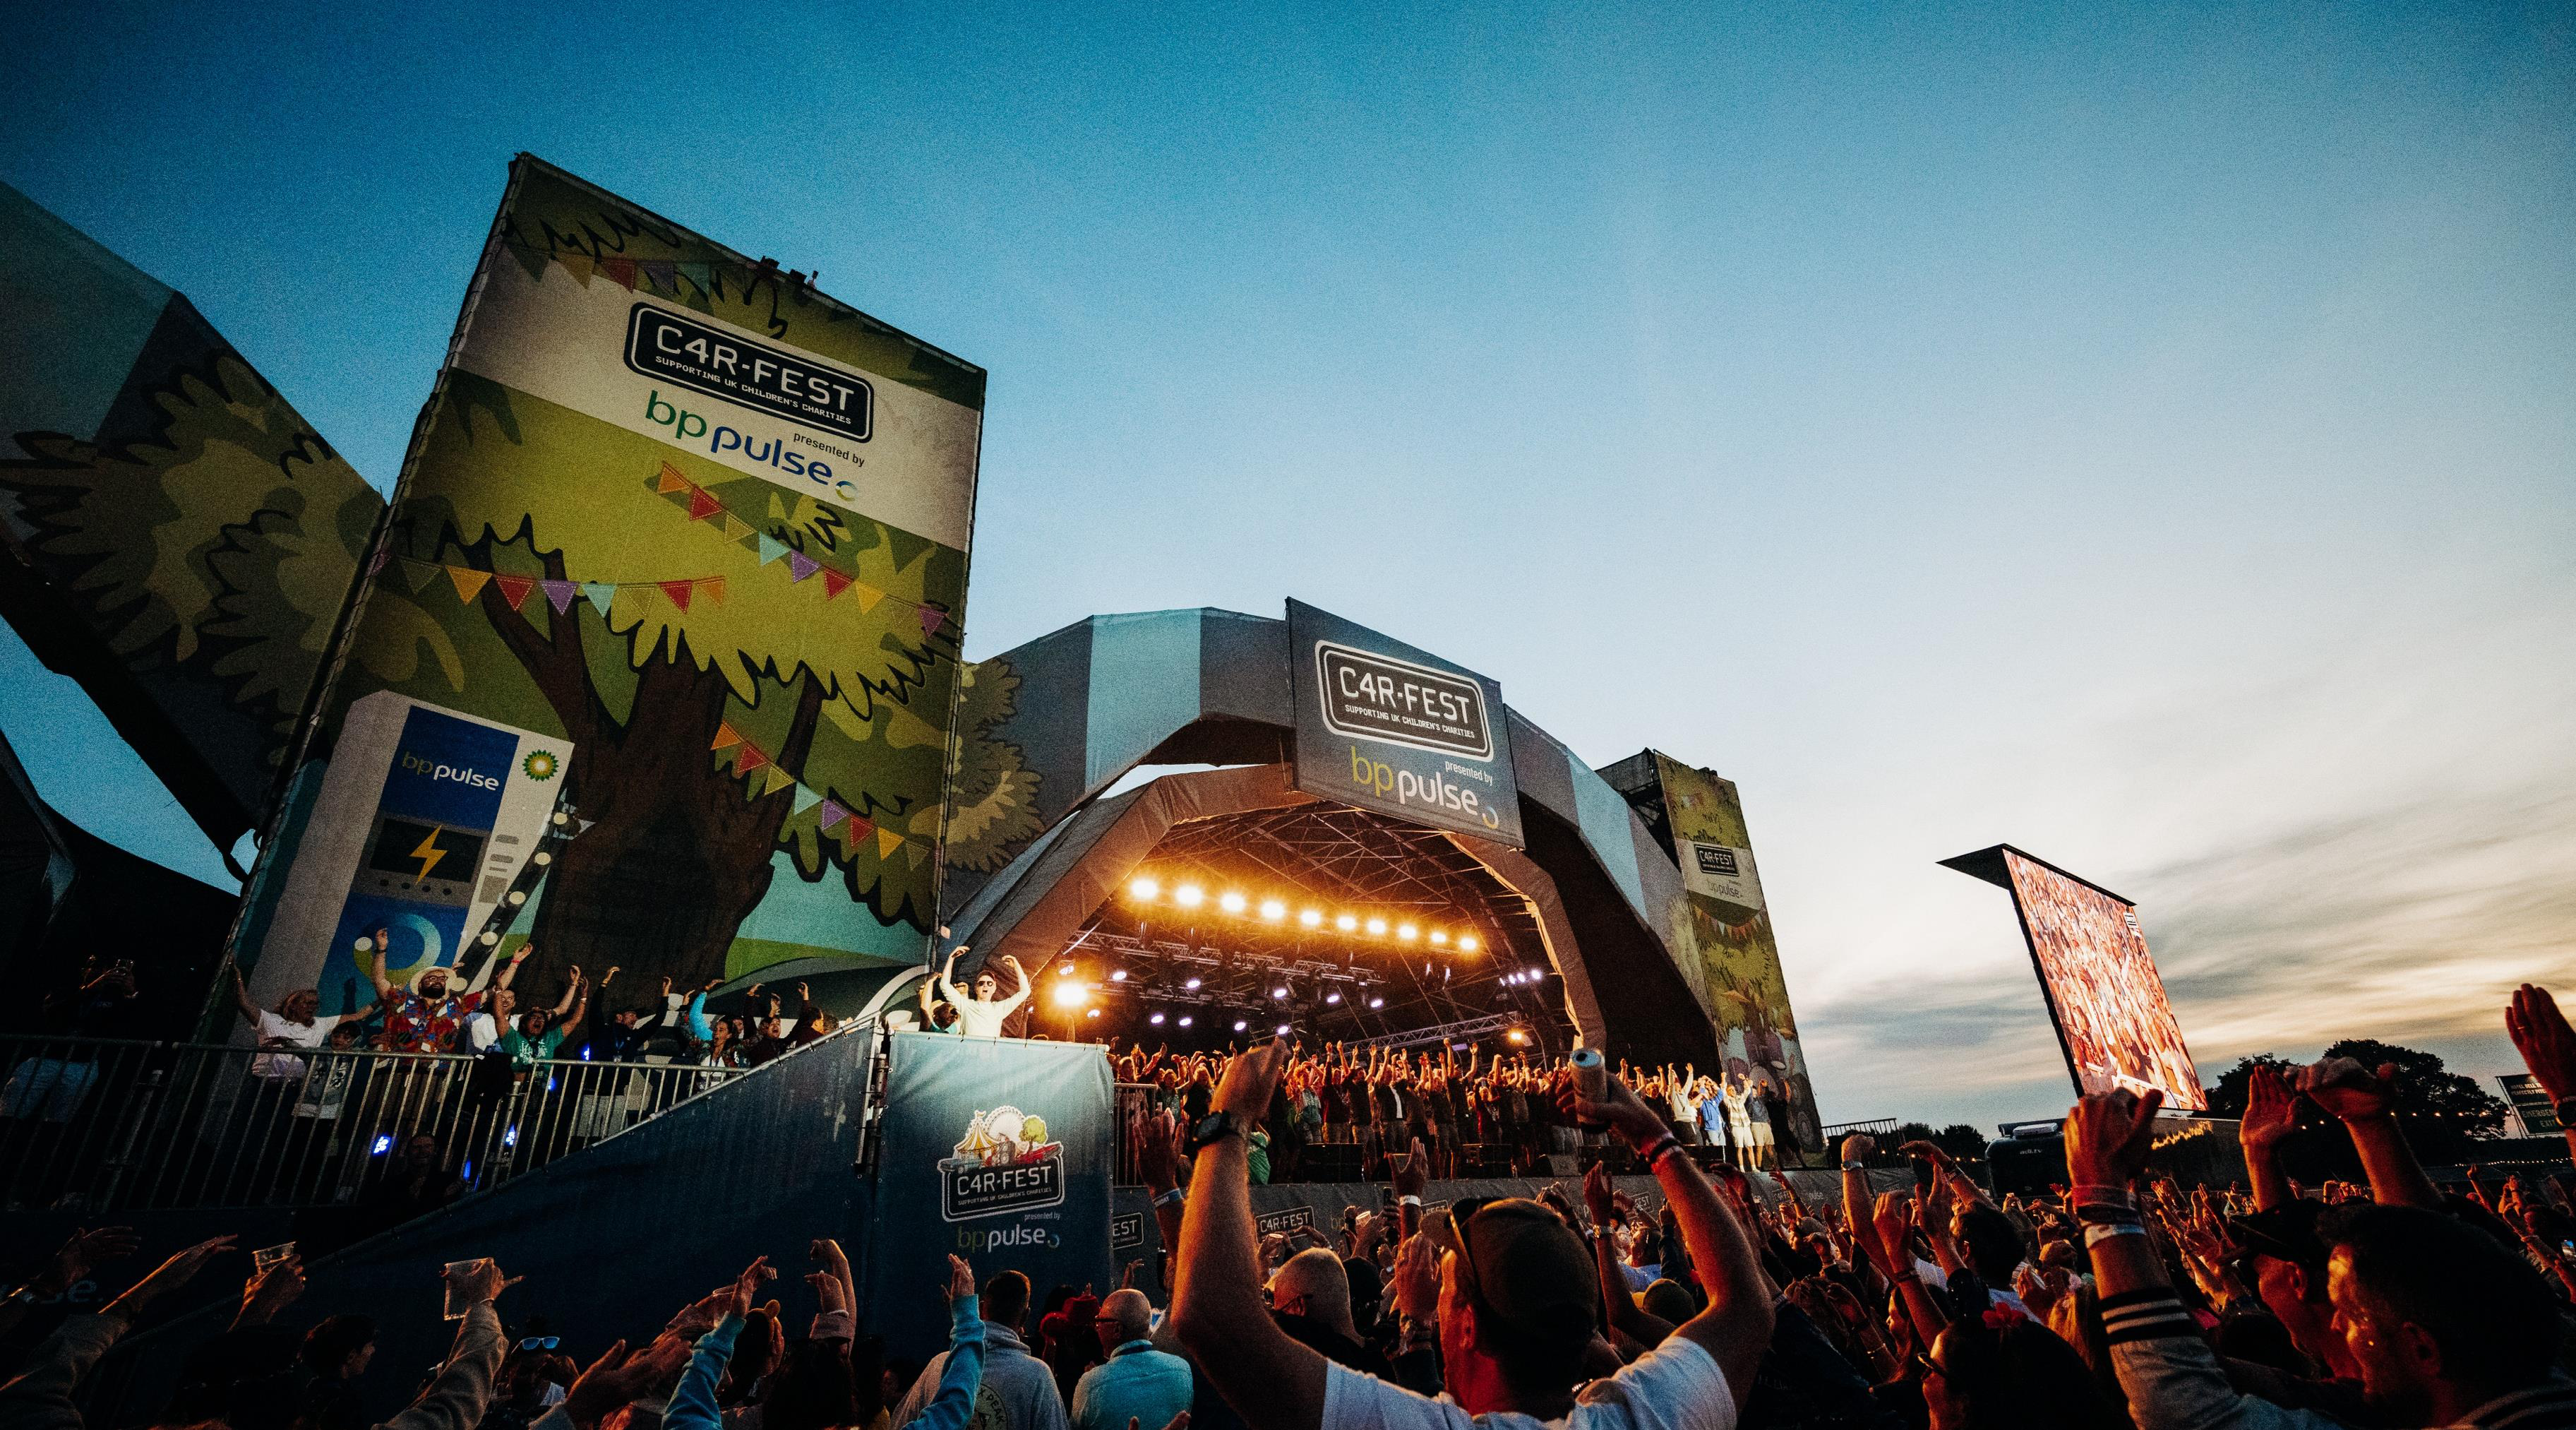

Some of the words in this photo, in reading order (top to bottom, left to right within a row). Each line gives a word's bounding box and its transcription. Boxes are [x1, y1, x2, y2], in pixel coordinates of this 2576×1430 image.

[655, 355, 721, 383] SUPPORTING
[724, 379, 738, 389] UK
[741, 384, 798, 408] CHILDREN'S
[802, 403, 851, 424] CHARITIES
[793, 432, 849, 460] presented
[853, 449, 865, 467] by
[1345, 704, 1389, 720] SUPPORTING
[1391, 714, 1401, 722] UK
[1402, 715, 1440, 732] CHILDREN'S
[1442, 725, 1475, 739] CHARITIES
[1445, 761, 1482, 781] presented
[1483, 771, 1493, 786] by
[1024, 1212, 1053, 1222] presented
[1054, 1211, 1061, 1220] by
[986, 1393, 1005, 1425] PEAK
